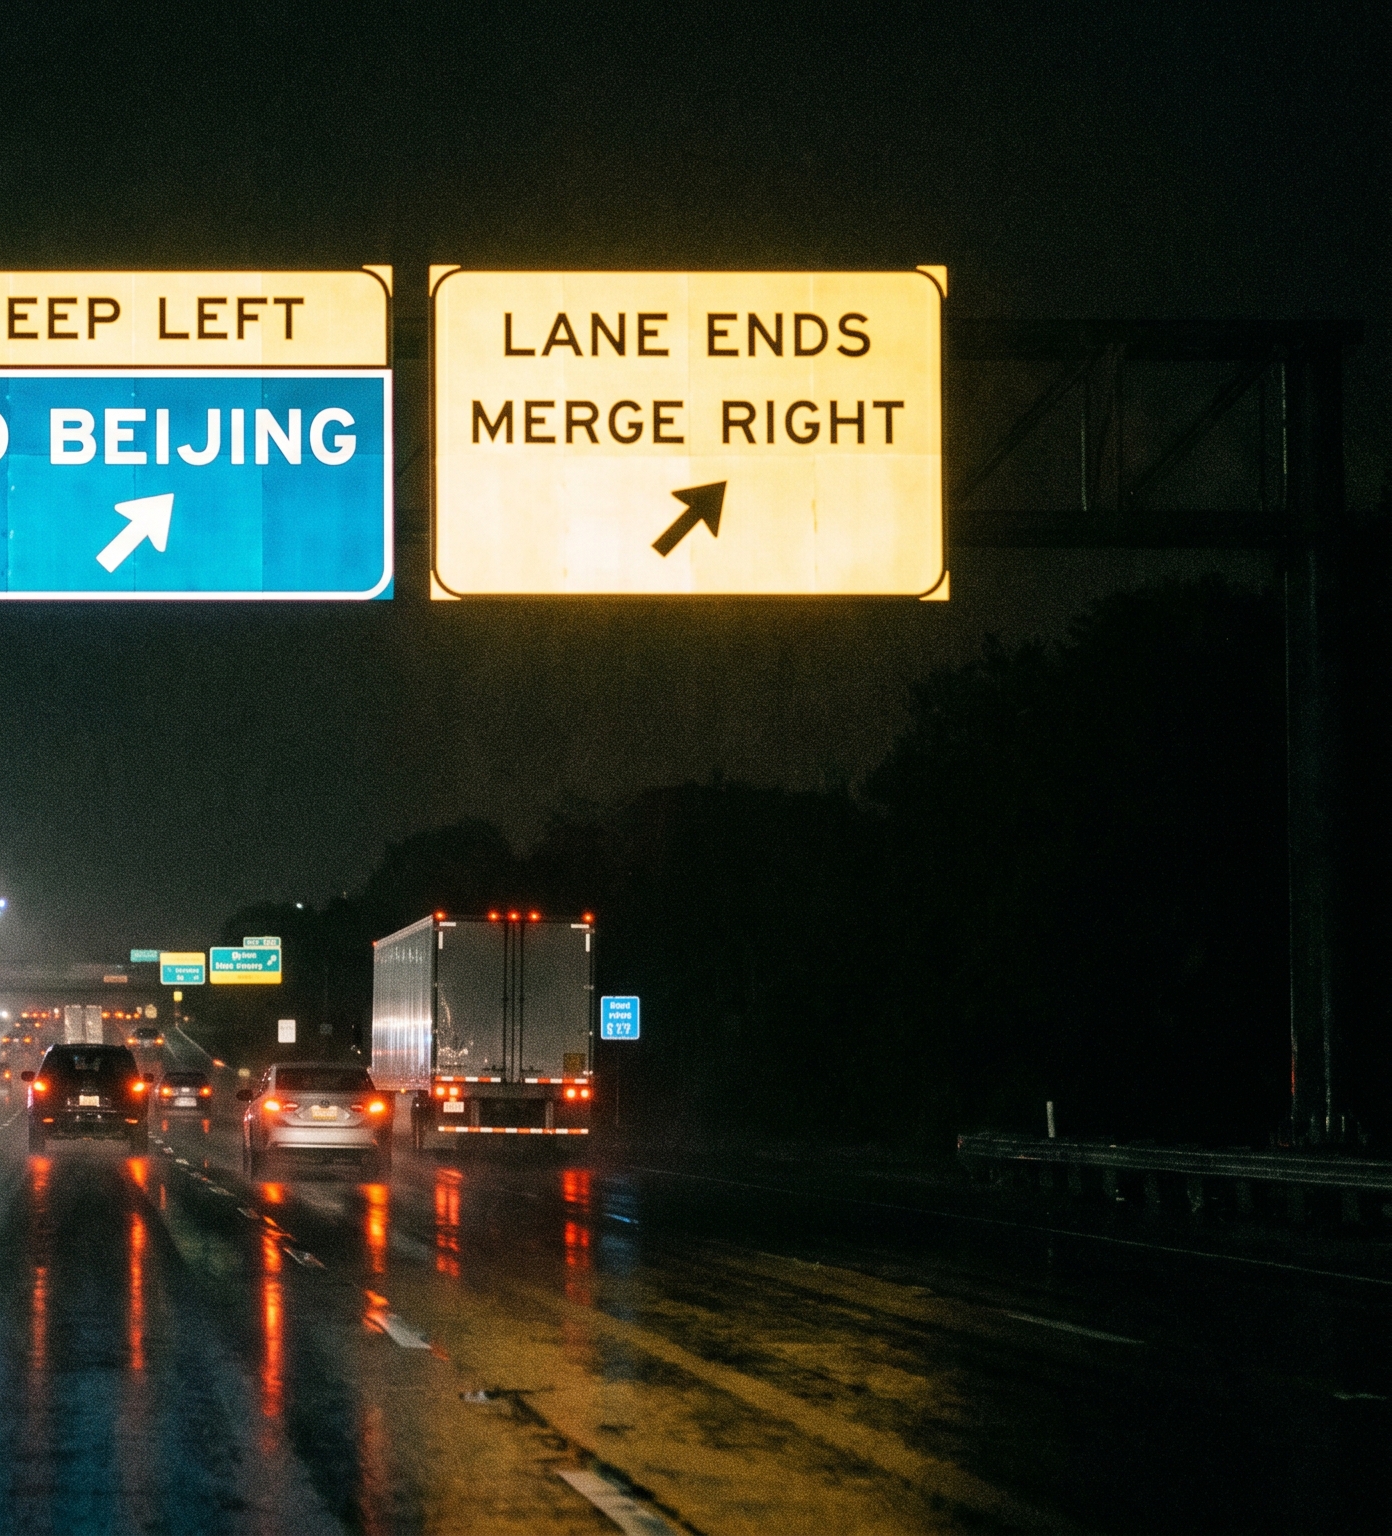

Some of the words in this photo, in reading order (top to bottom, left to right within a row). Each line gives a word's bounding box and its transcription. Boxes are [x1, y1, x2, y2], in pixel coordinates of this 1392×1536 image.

[159, 297, 304, 339] LEFT
[505, 313, 668, 356] LANE
[708, 313, 870, 357] ENDS
[51, 408, 356, 465] BEIJING
[473, 400, 684, 444] MERGE
[723, 400, 904, 444] RIGHT
